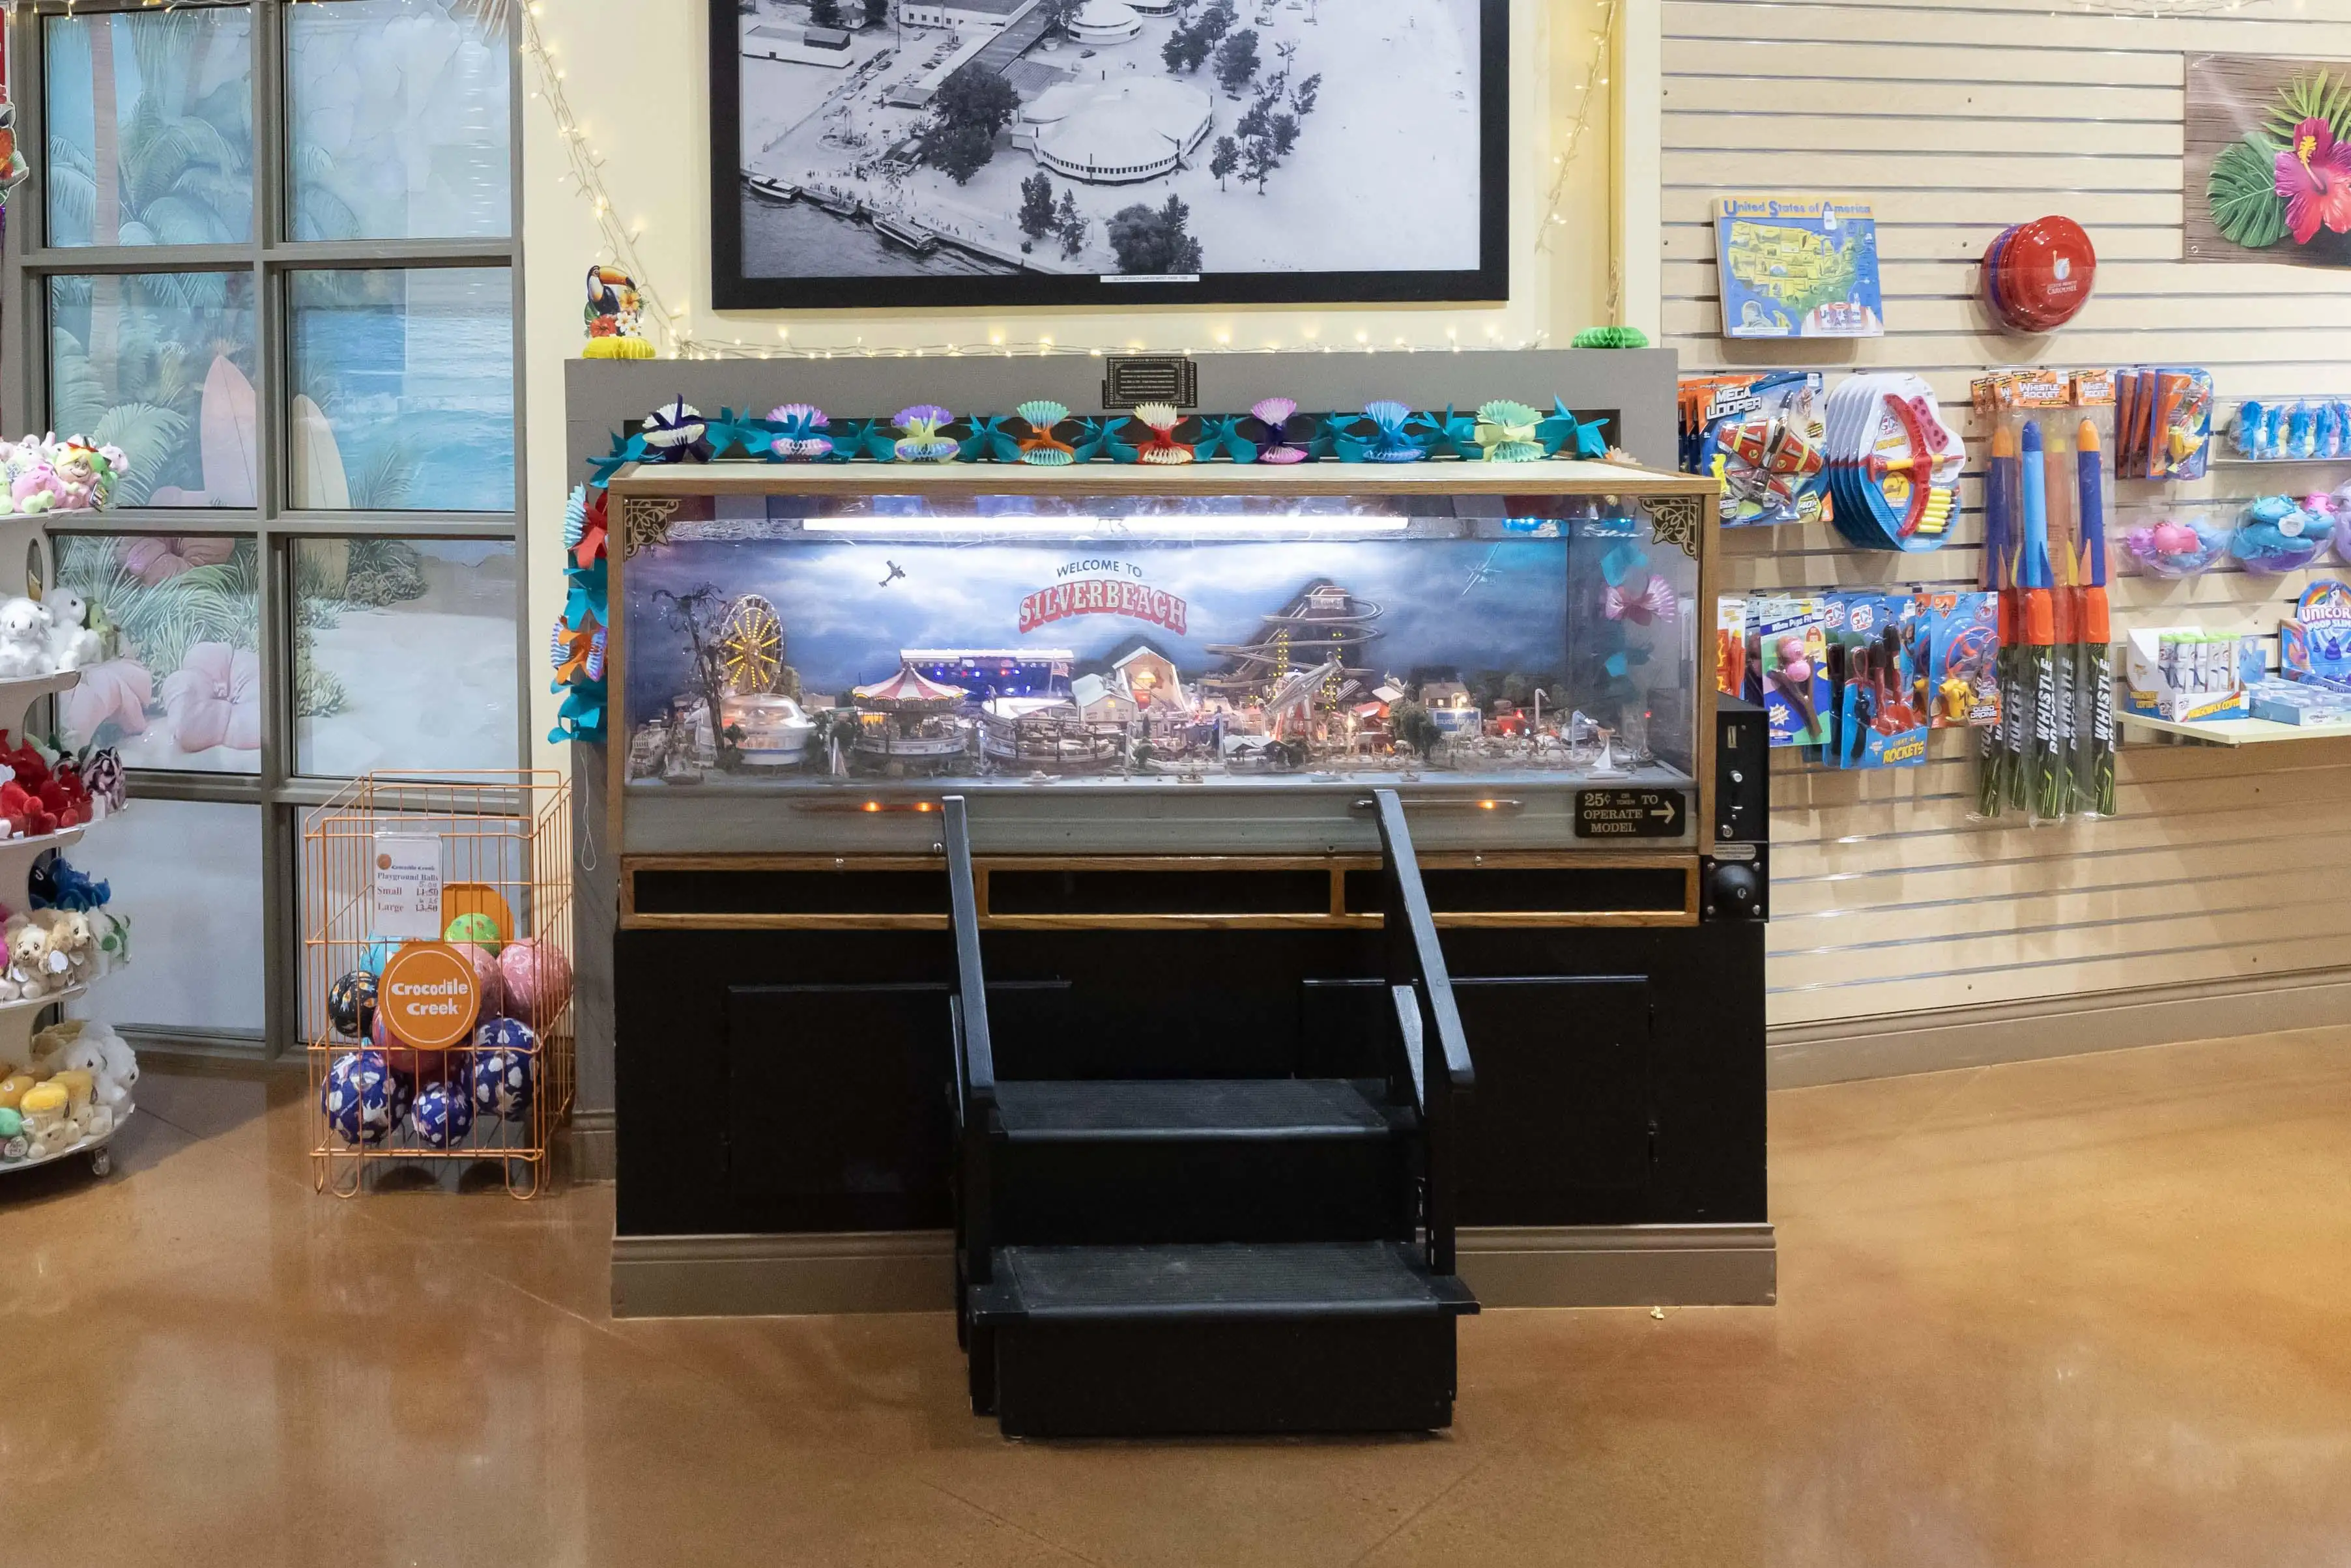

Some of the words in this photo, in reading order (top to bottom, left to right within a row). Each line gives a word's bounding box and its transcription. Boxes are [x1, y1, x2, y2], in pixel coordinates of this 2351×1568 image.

[1724, 199, 1765, 217] United
[1768, 200, 1806, 217] States
[1808, 199, 1819, 212] of
[2018, 382, 2060, 392] WHISTLE
[2022, 390, 2060, 399] ROCKET
[2081, 382, 2109, 391] WHISTLE
[1715, 386, 1752, 404] MEGA
[1705, 396, 1762, 420] LOOPER
[1056, 559, 1119, 578] WELCOME
[1125, 562, 1142, 578] TO
[2036, 657, 2053, 741] WHISTLE
[2058, 657, 2073, 737] WHISTLE
[2094, 658, 2111, 741] WHISTLE
[1970, 710, 1997, 719] DRONE
[1882, 740, 1925, 764] ROCKETS
[1584, 792, 1611, 807] 25¢
[1641, 794, 1659, 805] TO
[1583, 808, 1643, 820] OPERATE
[1591, 822, 1637, 833] MODEL
[377, 872, 419, 882] Playground
[377, 886, 402, 896] Small
[378, 902, 404, 913] Large
[391, 977, 469, 996] Crocodile
[406, 997, 459, 1016] Creek
